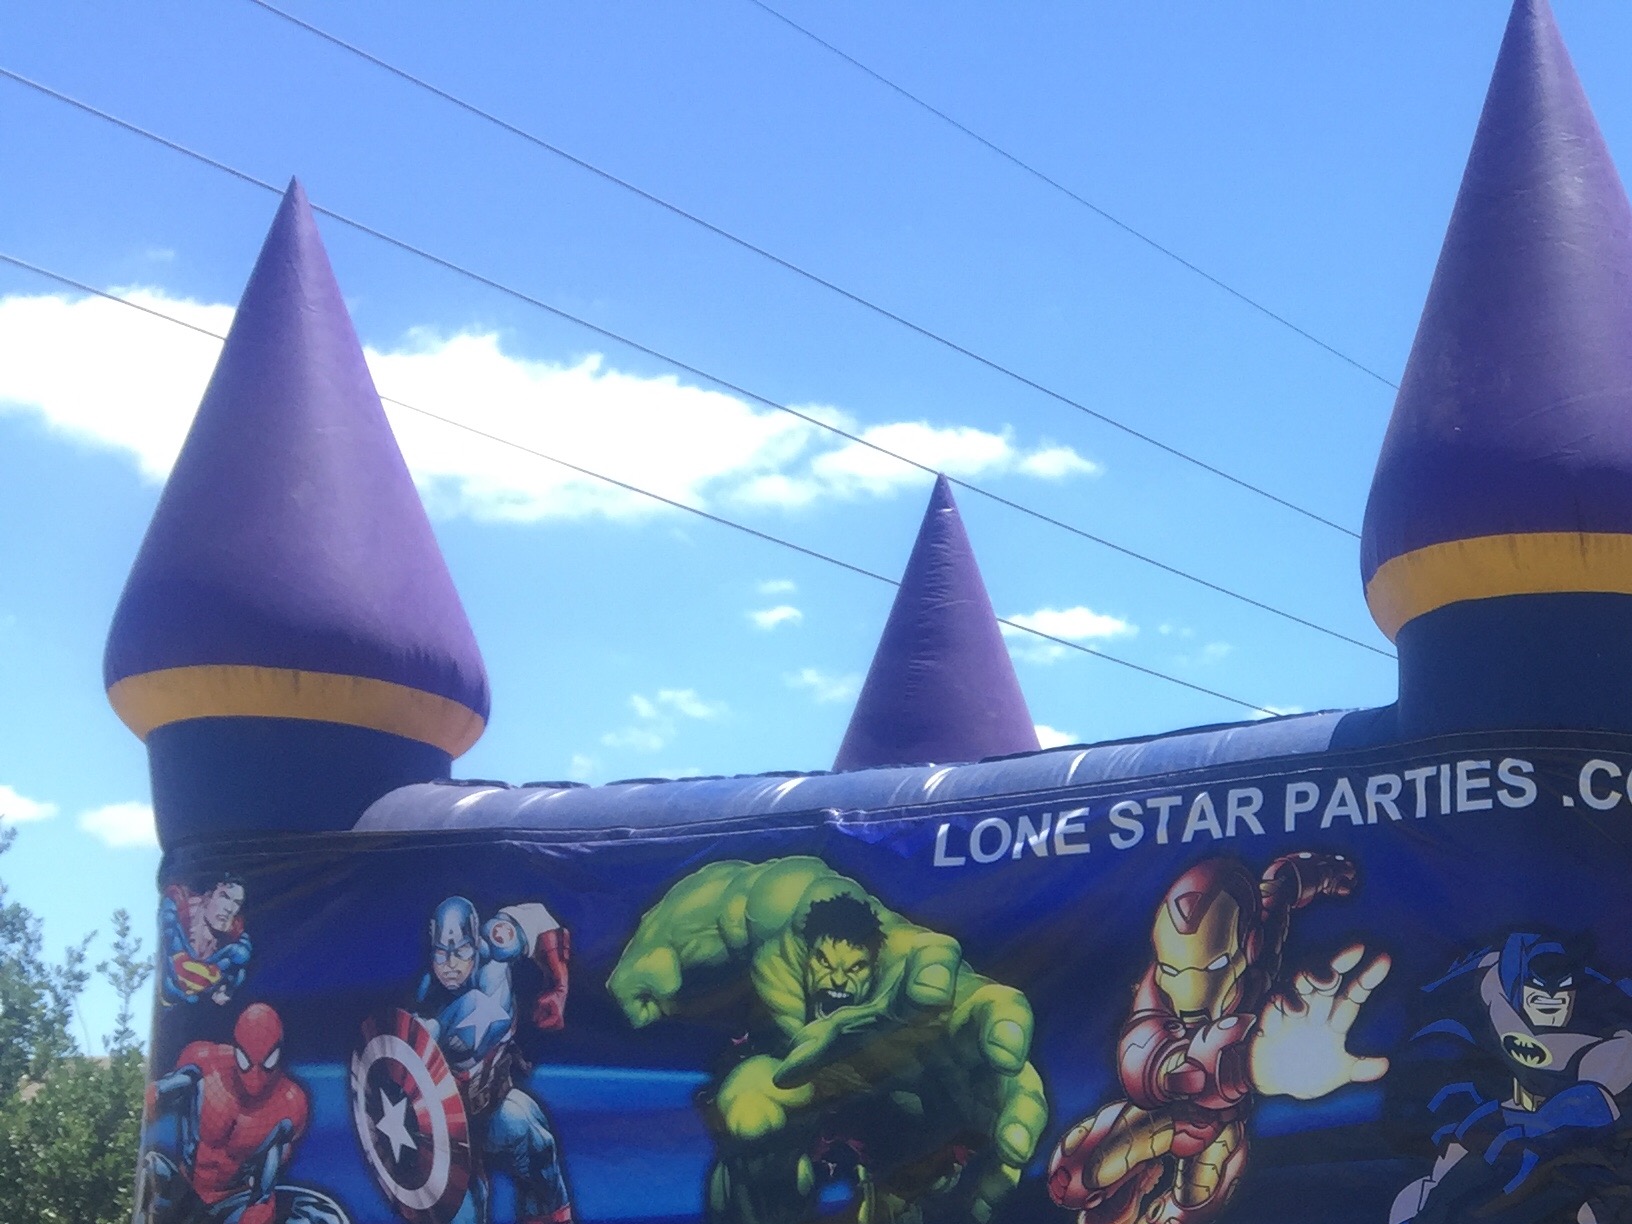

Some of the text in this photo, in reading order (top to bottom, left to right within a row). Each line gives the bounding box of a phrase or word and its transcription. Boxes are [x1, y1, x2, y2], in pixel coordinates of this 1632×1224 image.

[933, 806, 1091, 867] LONE
[1108, 786, 1266, 850] STAR
[1284, 757, 1538, 833] PARTIES
